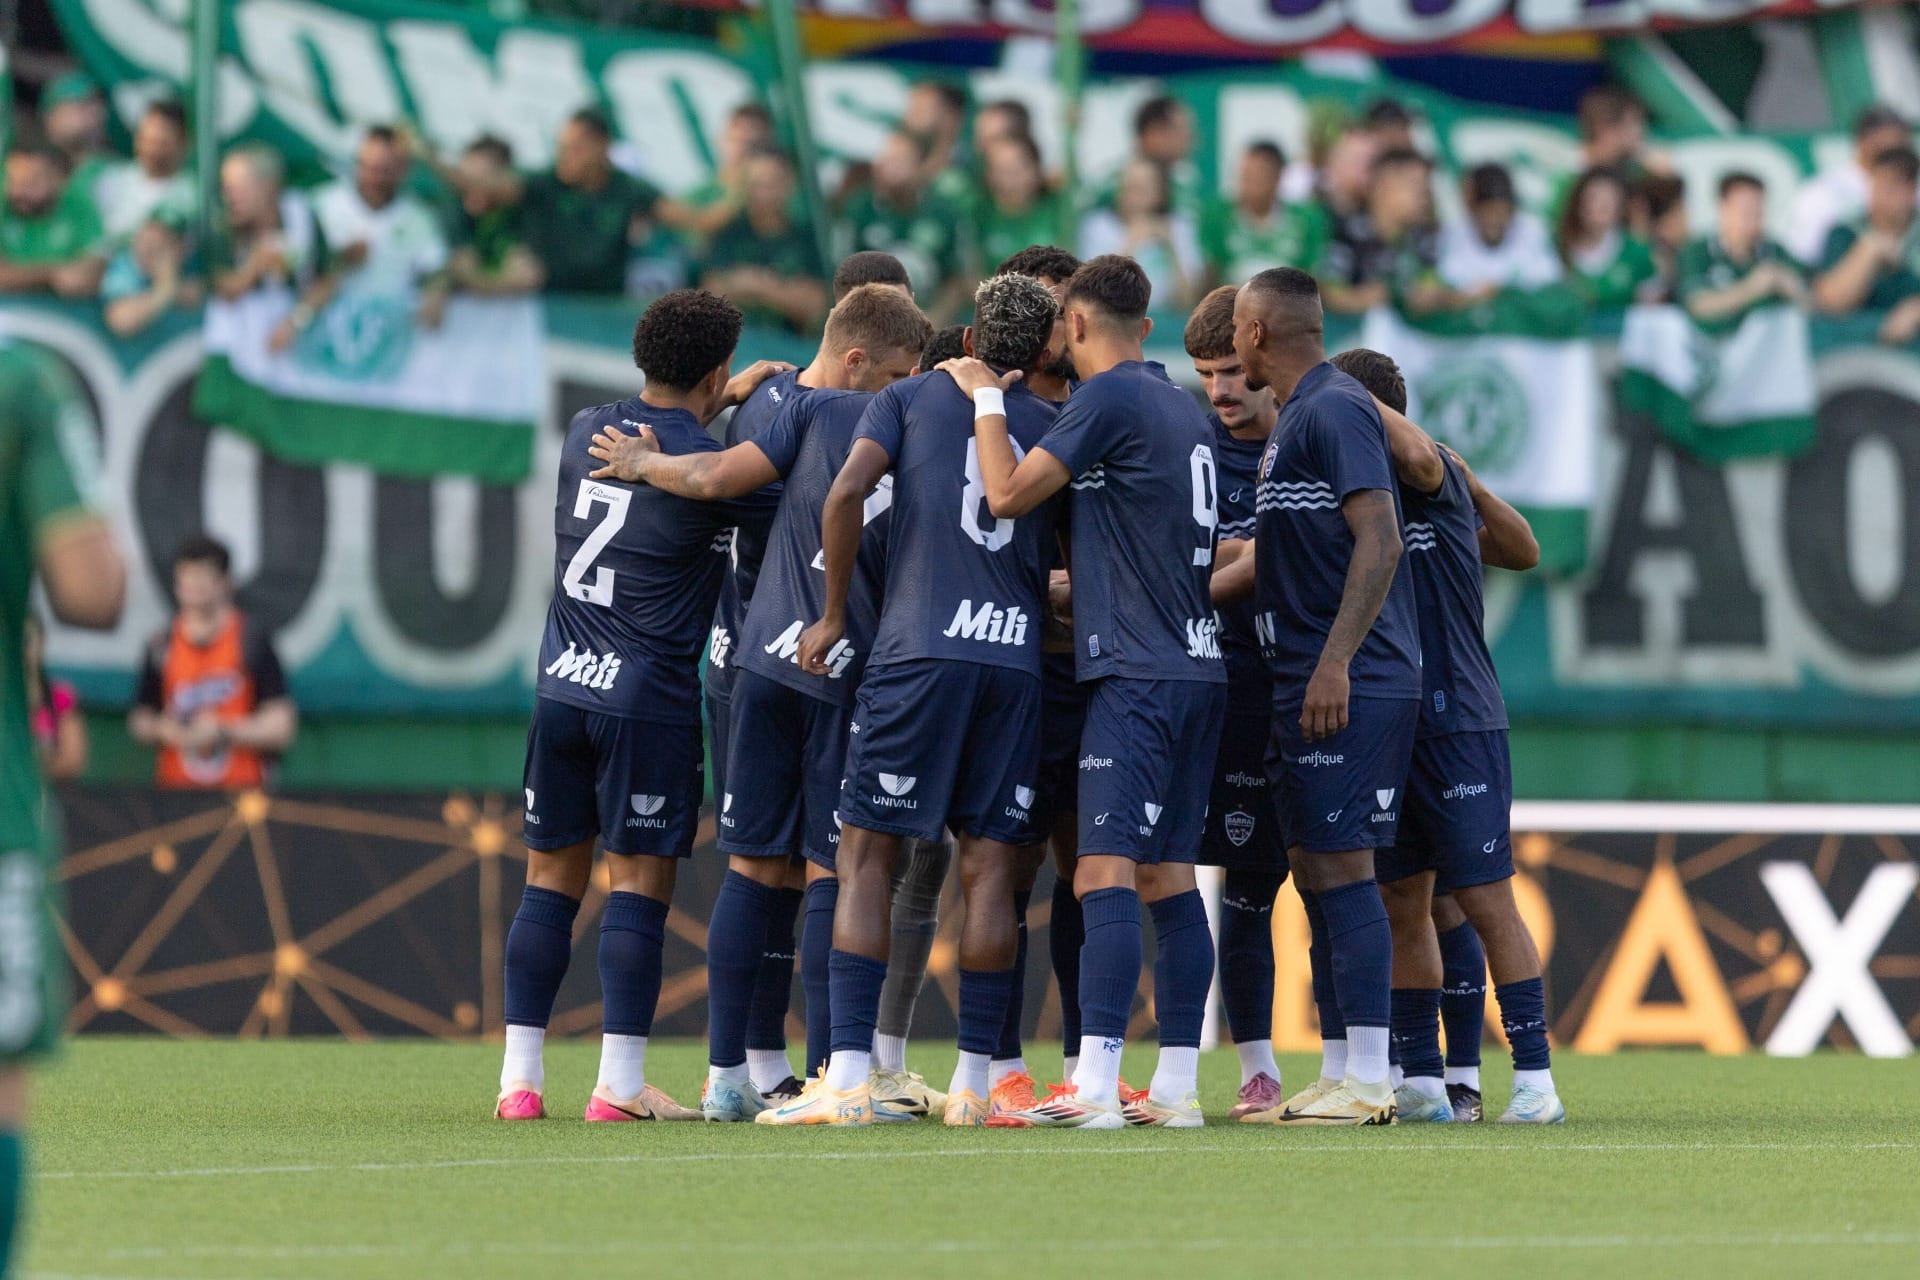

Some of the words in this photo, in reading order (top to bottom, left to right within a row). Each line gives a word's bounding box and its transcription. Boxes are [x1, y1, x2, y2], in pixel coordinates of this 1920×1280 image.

[1190, 443, 1219, 567] 9
[562, 478, 633, 608] 2
[943, 599, 1028, 646] Mili
[545, 641, 622, 690] Mili
[1298, 751, 1345, 767] unifique
[1225, 771, 1267, 788] unifique
[1442, 783, 1488, 800] unifique
[872, 795, 917, 809] UNIVALI
[626, 818, 666, 829] UNIVALI
